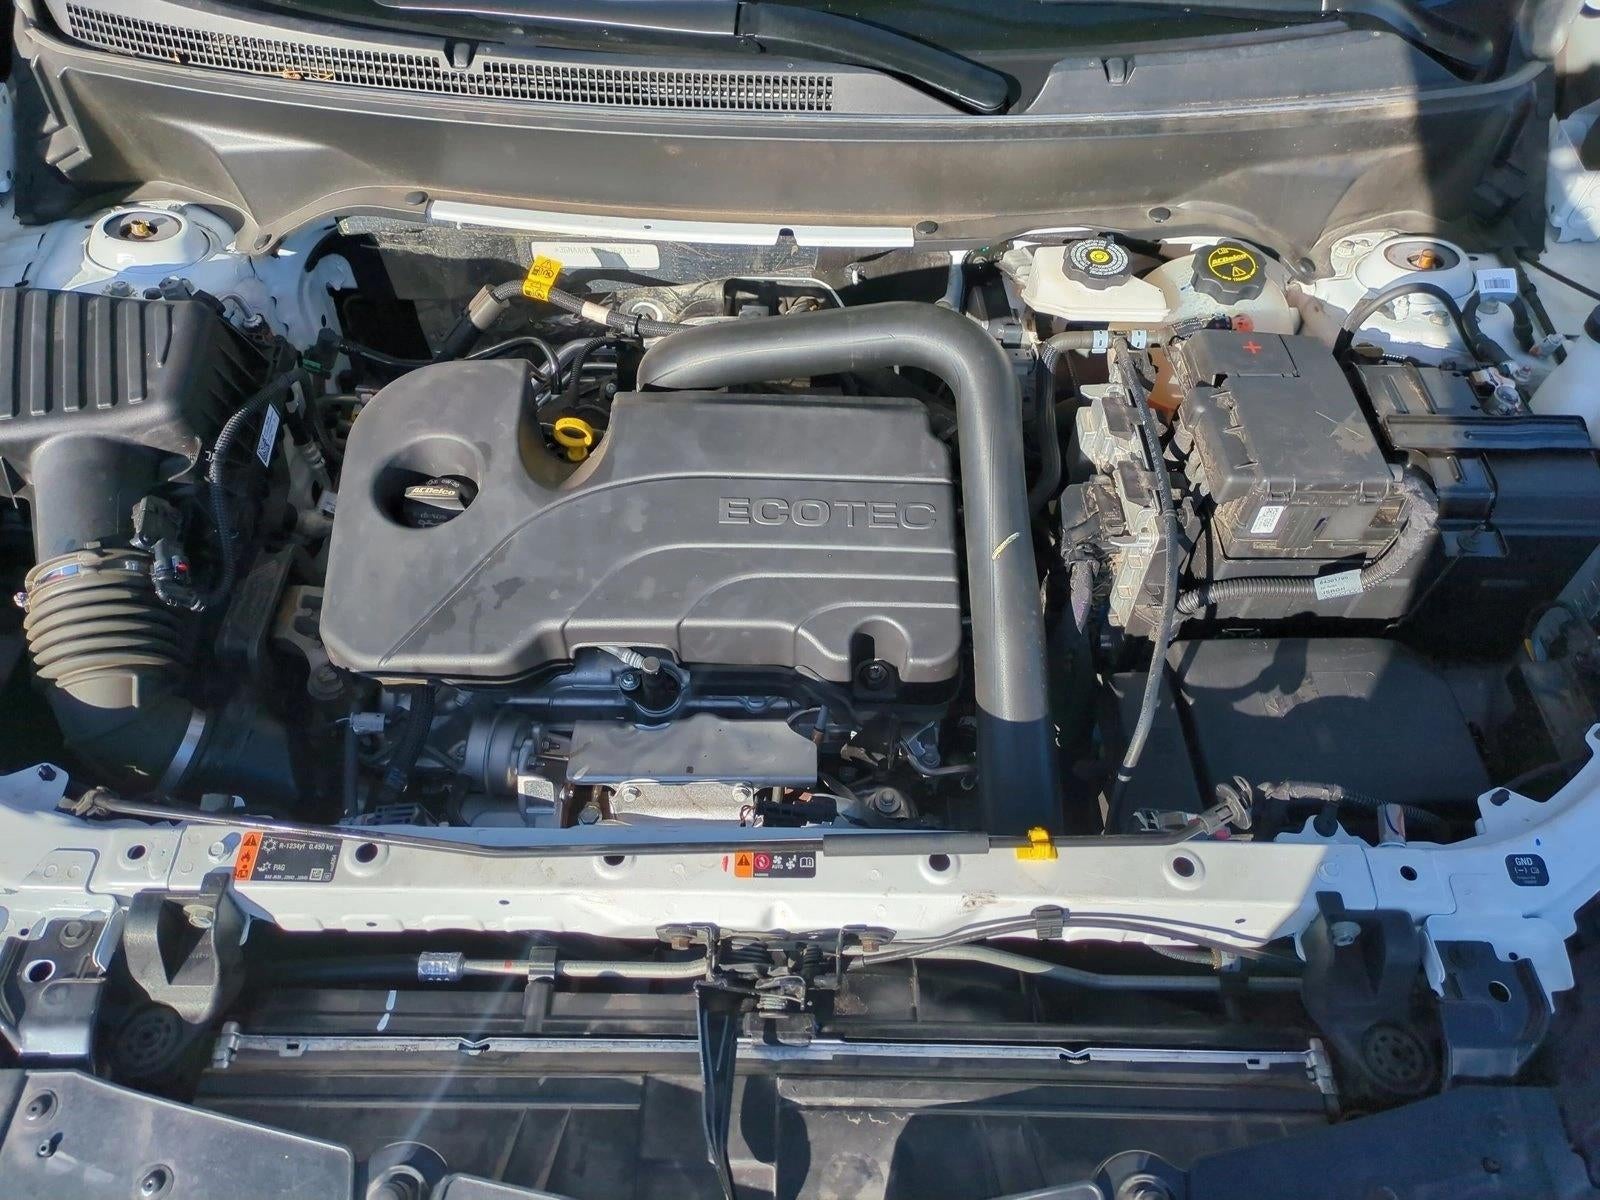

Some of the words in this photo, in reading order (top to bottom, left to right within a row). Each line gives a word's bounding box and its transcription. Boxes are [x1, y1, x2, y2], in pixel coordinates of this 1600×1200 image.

[412, 487, 456, 496] ACDelco
[718, 497, 937, 530] ECOTEC
[1515, 857, 1533, 866] GND
[273, 863, 286, 871] PAG
